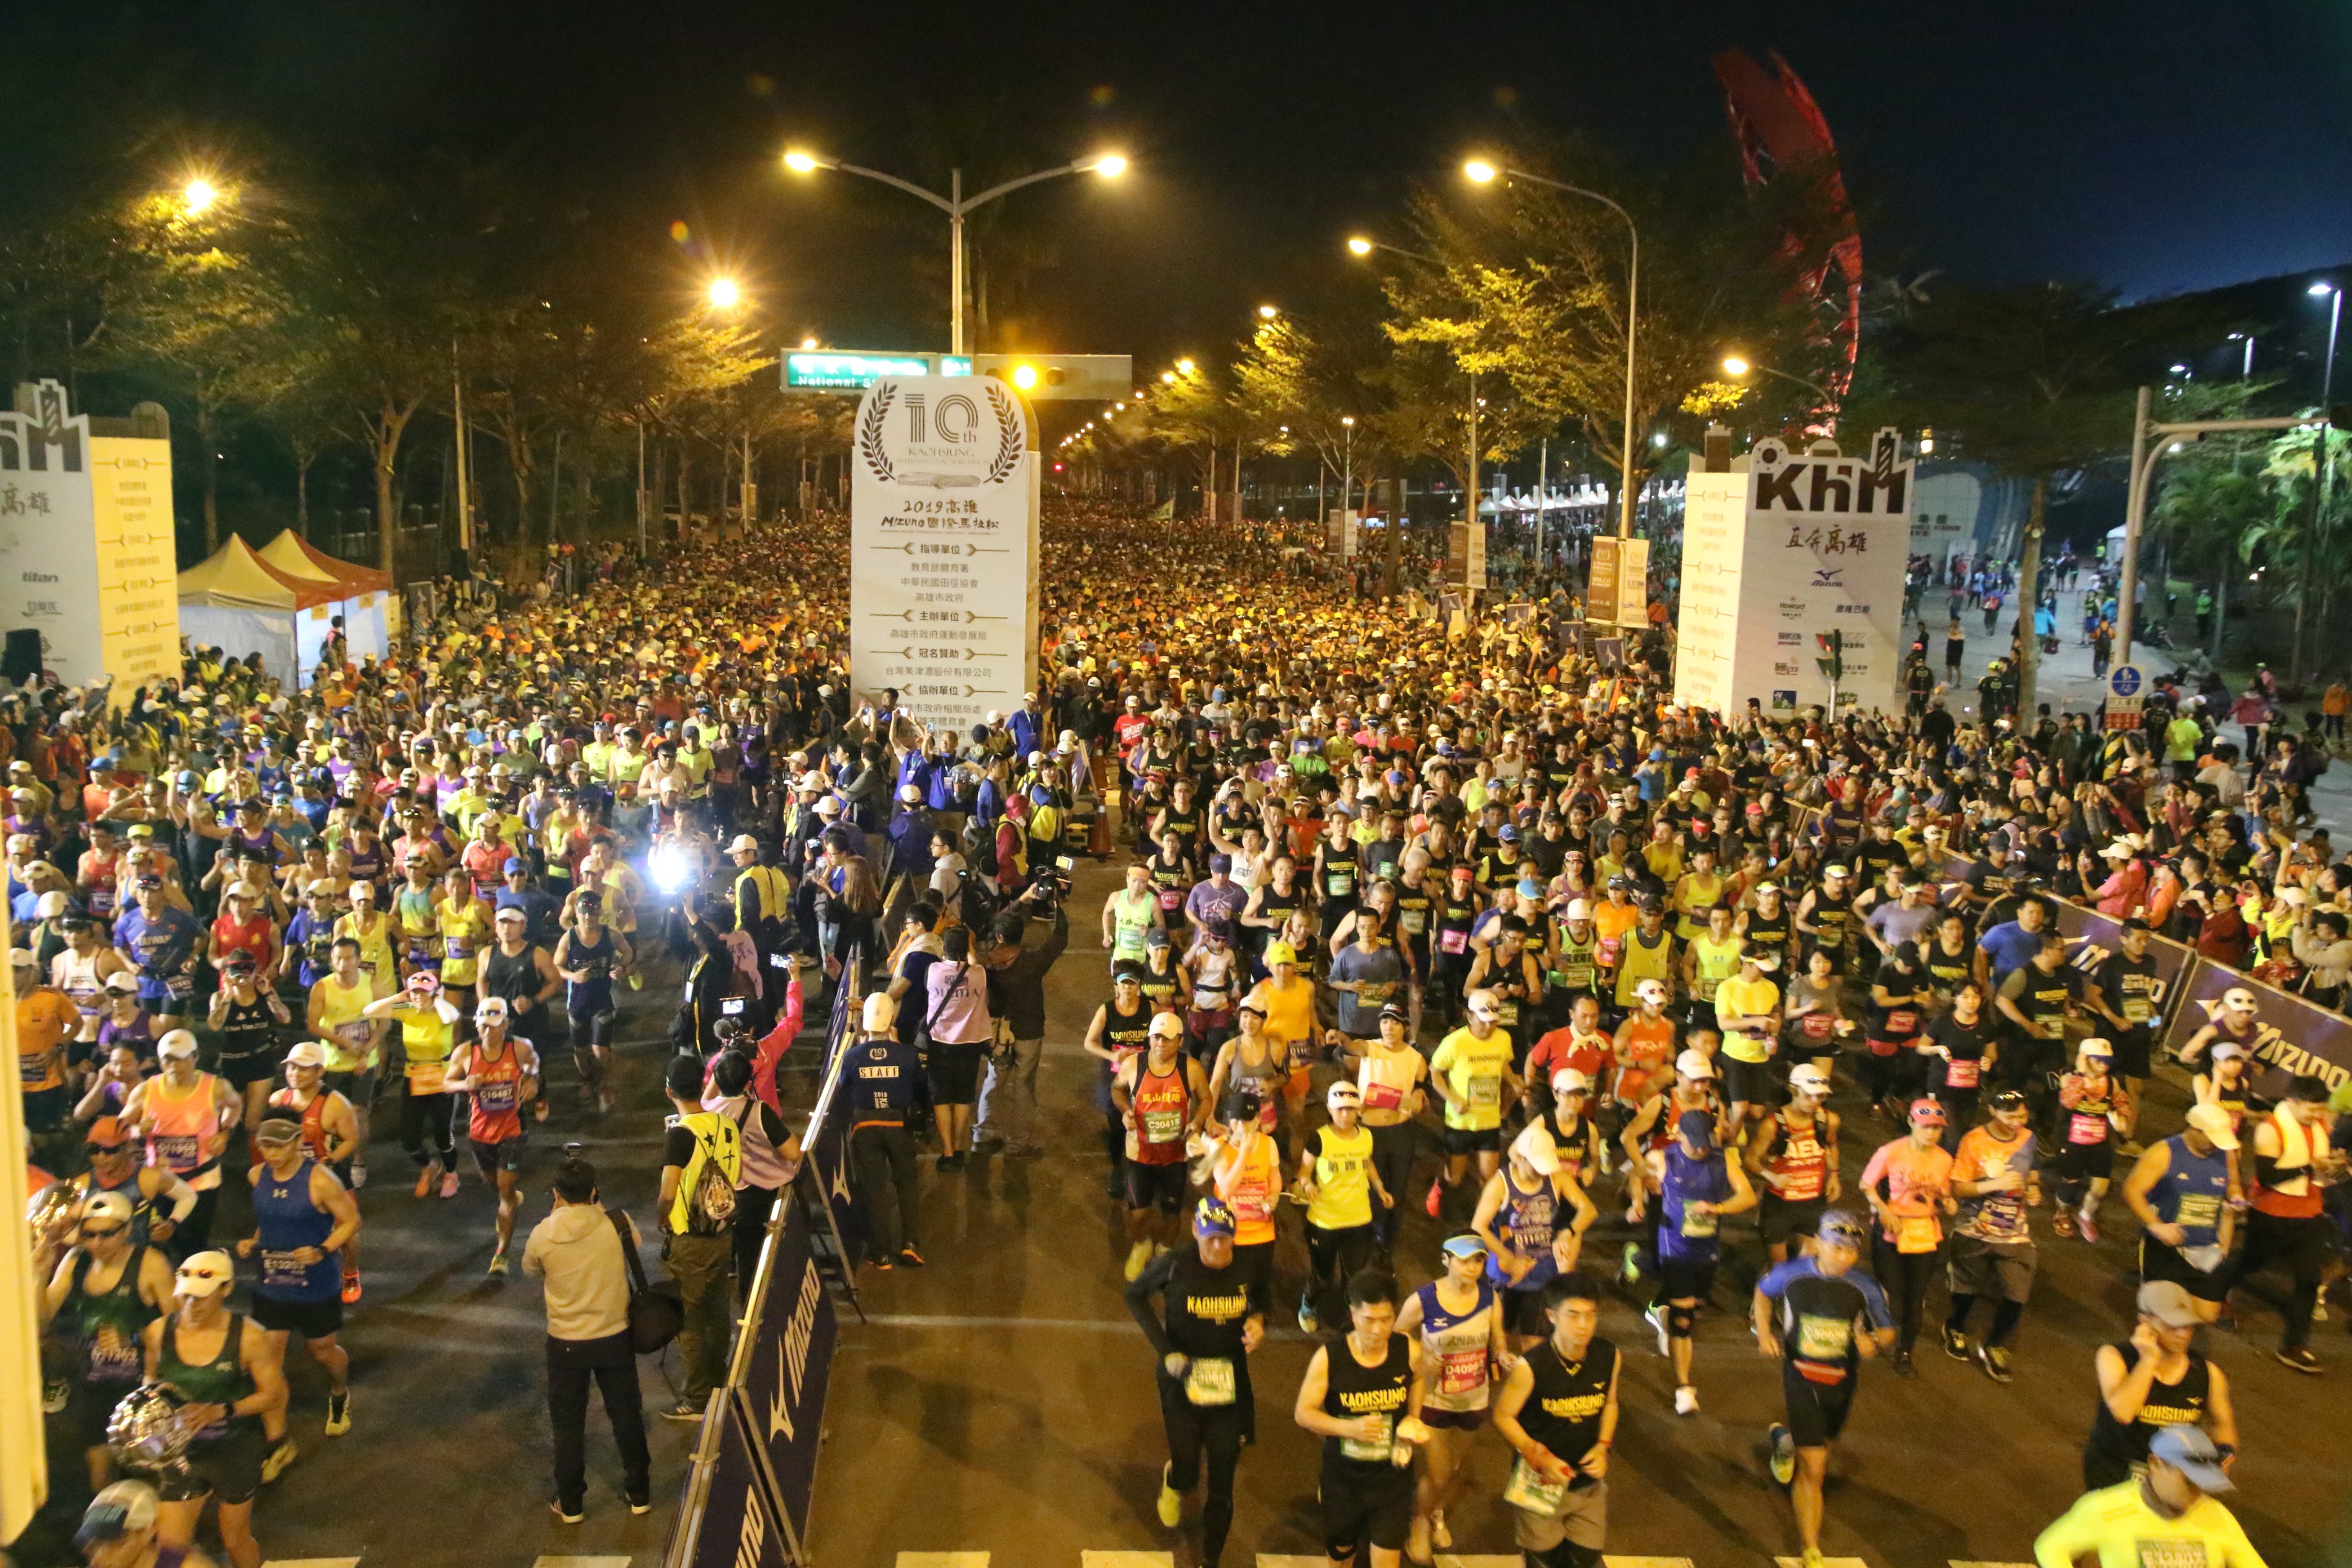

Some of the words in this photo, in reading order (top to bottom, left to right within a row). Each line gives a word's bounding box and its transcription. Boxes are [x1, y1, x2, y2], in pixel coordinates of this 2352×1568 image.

[798, 376, 856, 387] National
[920, 543, 961, 554] 指導單位
[911, 562, 969, 573] 教育部體育署
[901, 577, 979, 589] 中華民國田徑協會
[915, 592, 964, 603] 高雄市政府
[919, 611, 959, 622] 主辦單位
[890, 629, 988, 642] 高雄市政府運動發展局
[919, 647, 959, 659] 冠名贊助
[919, 684, 959, 696] 協辦單位
[1467, 1054, 1502, 1063] RUNNING
[860, 1067, 898, 1077] STAFF
[784, 1257, 821, 1408] MIZUNO
[1339, 1386, 1407, 1408] KAOHSIUNG
